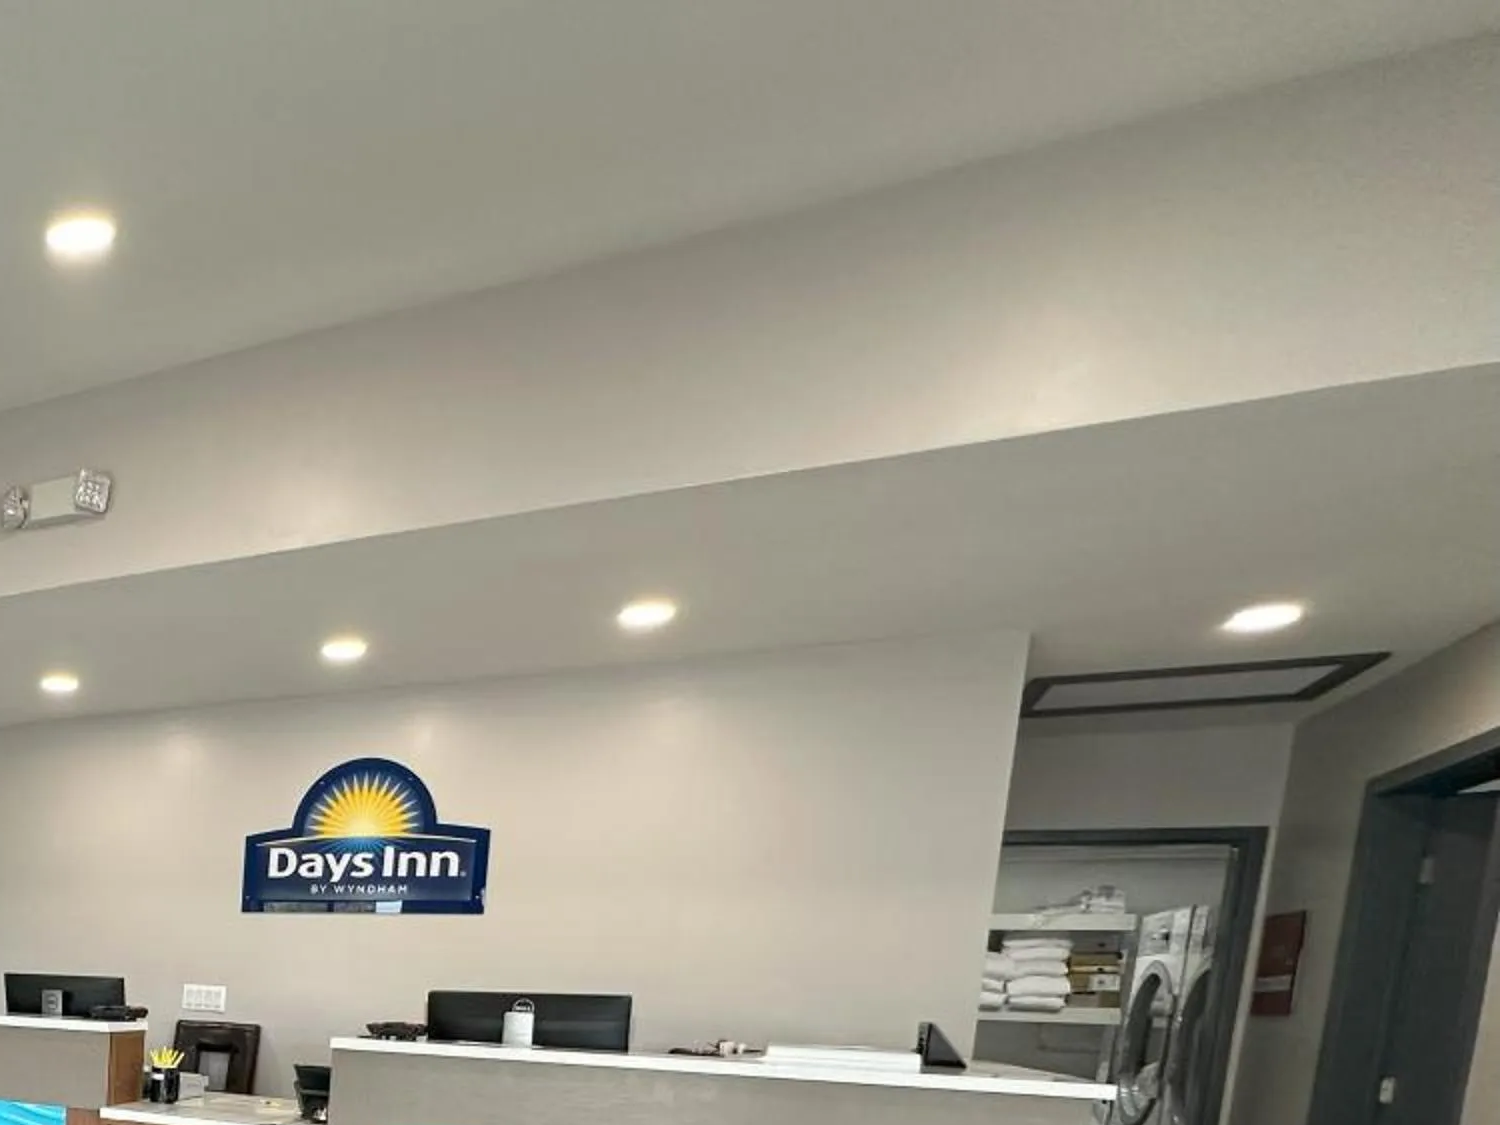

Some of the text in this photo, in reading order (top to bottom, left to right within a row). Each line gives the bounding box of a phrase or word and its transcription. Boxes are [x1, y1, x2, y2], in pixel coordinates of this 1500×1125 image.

[267, 846, 460, 882] Days Inn
[310, 883, 408, 895] BY WYNDHAM
